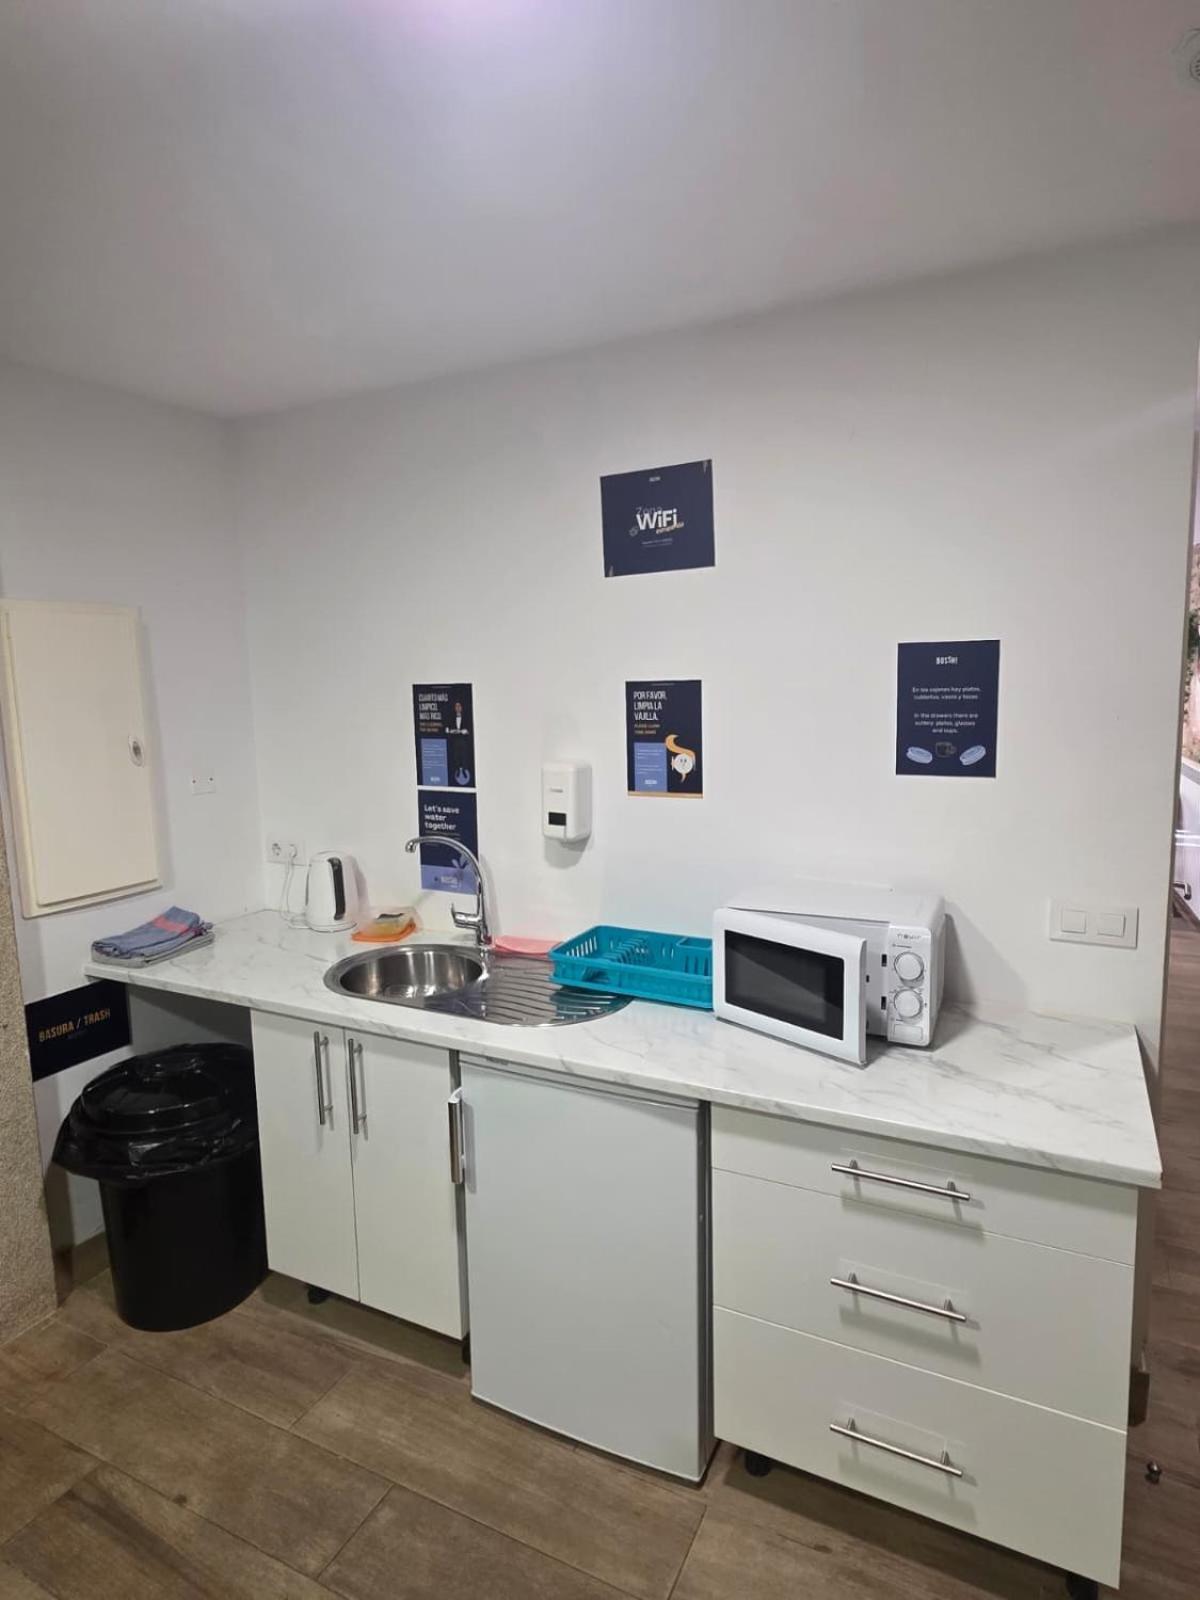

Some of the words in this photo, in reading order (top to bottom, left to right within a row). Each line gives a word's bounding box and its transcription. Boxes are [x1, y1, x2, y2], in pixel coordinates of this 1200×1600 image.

[636, 508, 677, 530] WiFi
[633, 690, 646, 700] POR
[633, 701, 654, 711] LIMPIA
[654, 701, 663, 710] LA
[423, 804, 442, 813] Let's
[424, 821, 456, 830] together
[39, 1020, 75, 1042] BASURA
[84, 1007, 111, 1026] TRASH
